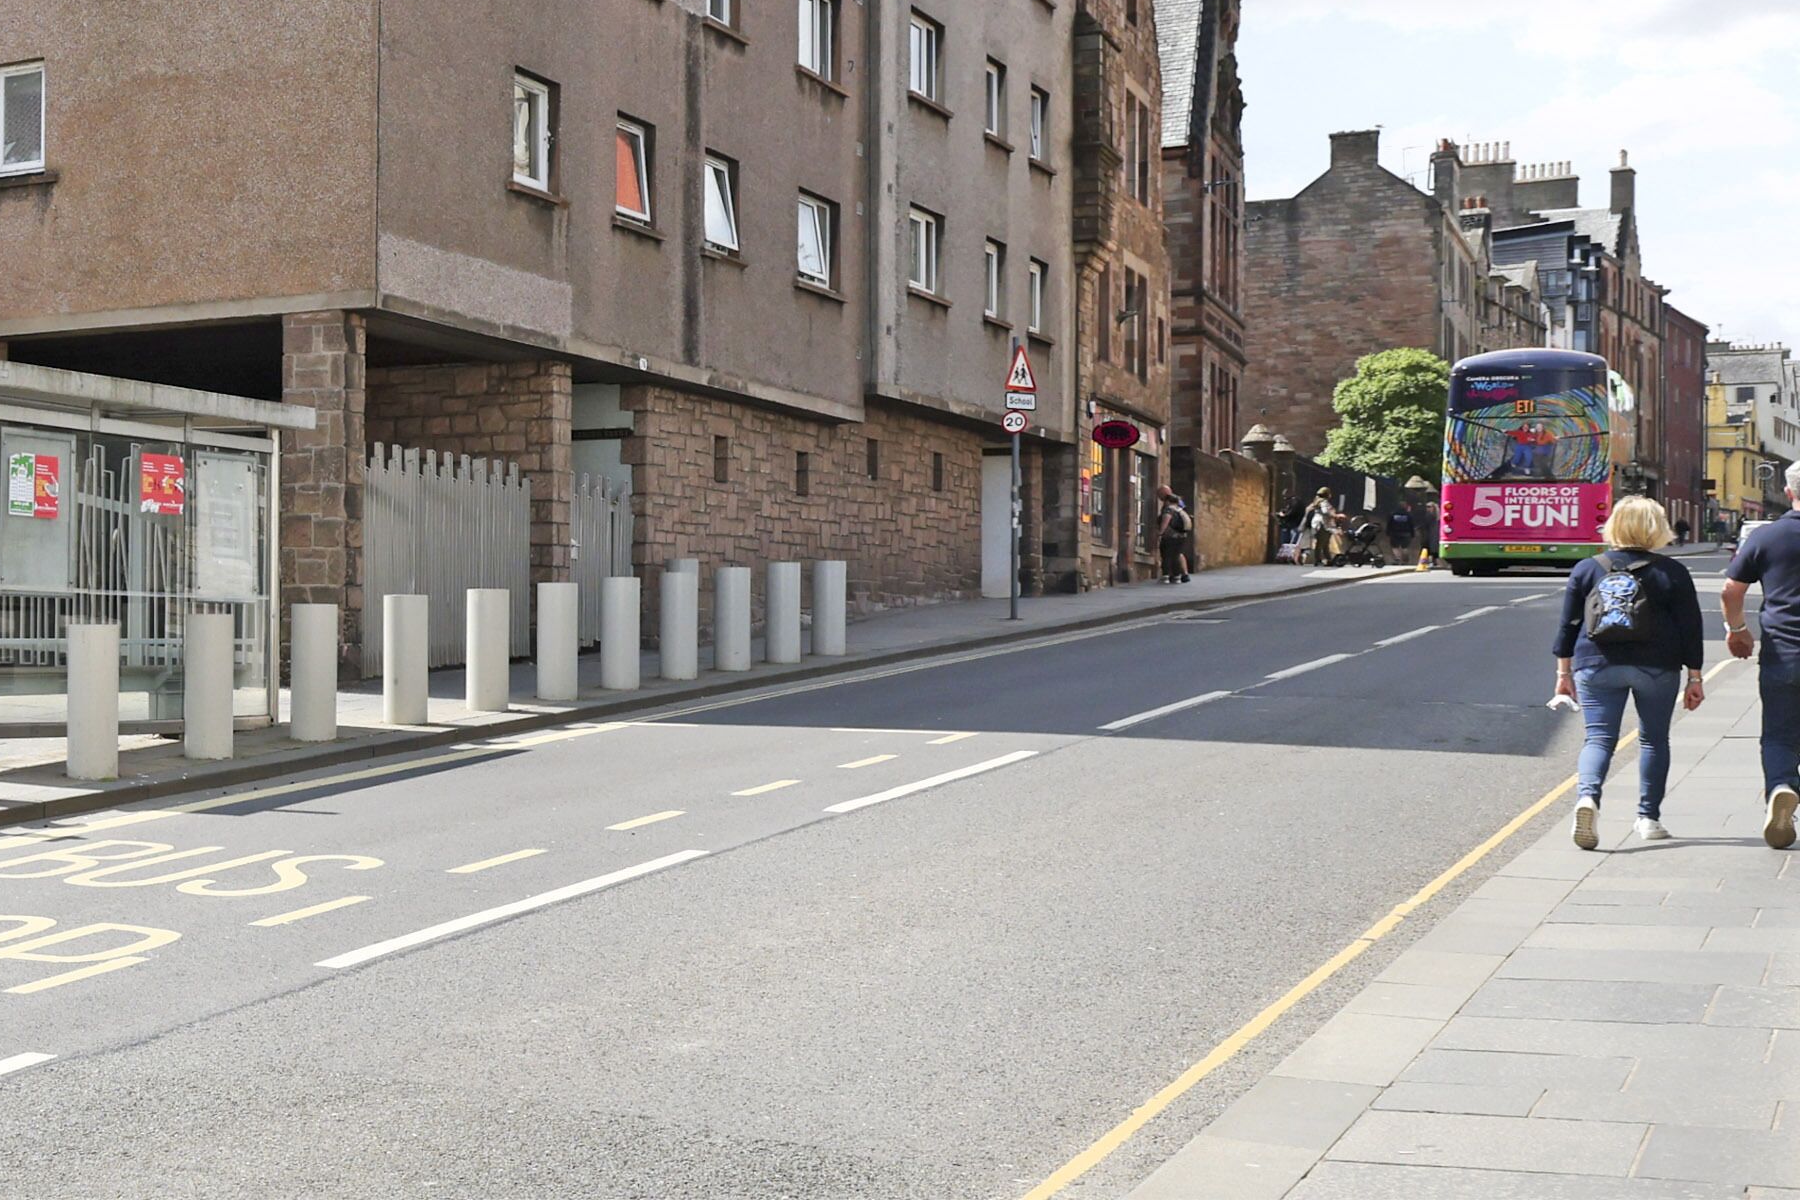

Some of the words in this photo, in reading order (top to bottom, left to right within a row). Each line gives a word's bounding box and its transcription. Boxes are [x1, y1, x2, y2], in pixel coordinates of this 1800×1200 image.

[1010, 396, 1032, 405] School
[1006, 417, 1023, 426] 20
[1469, 487, 1503, 526] 5
[1505, 487, 1556, 496] FLOORS
[1560, 487, 1579, 496] OF
[1504, 505, 1579, 527] FUN!
